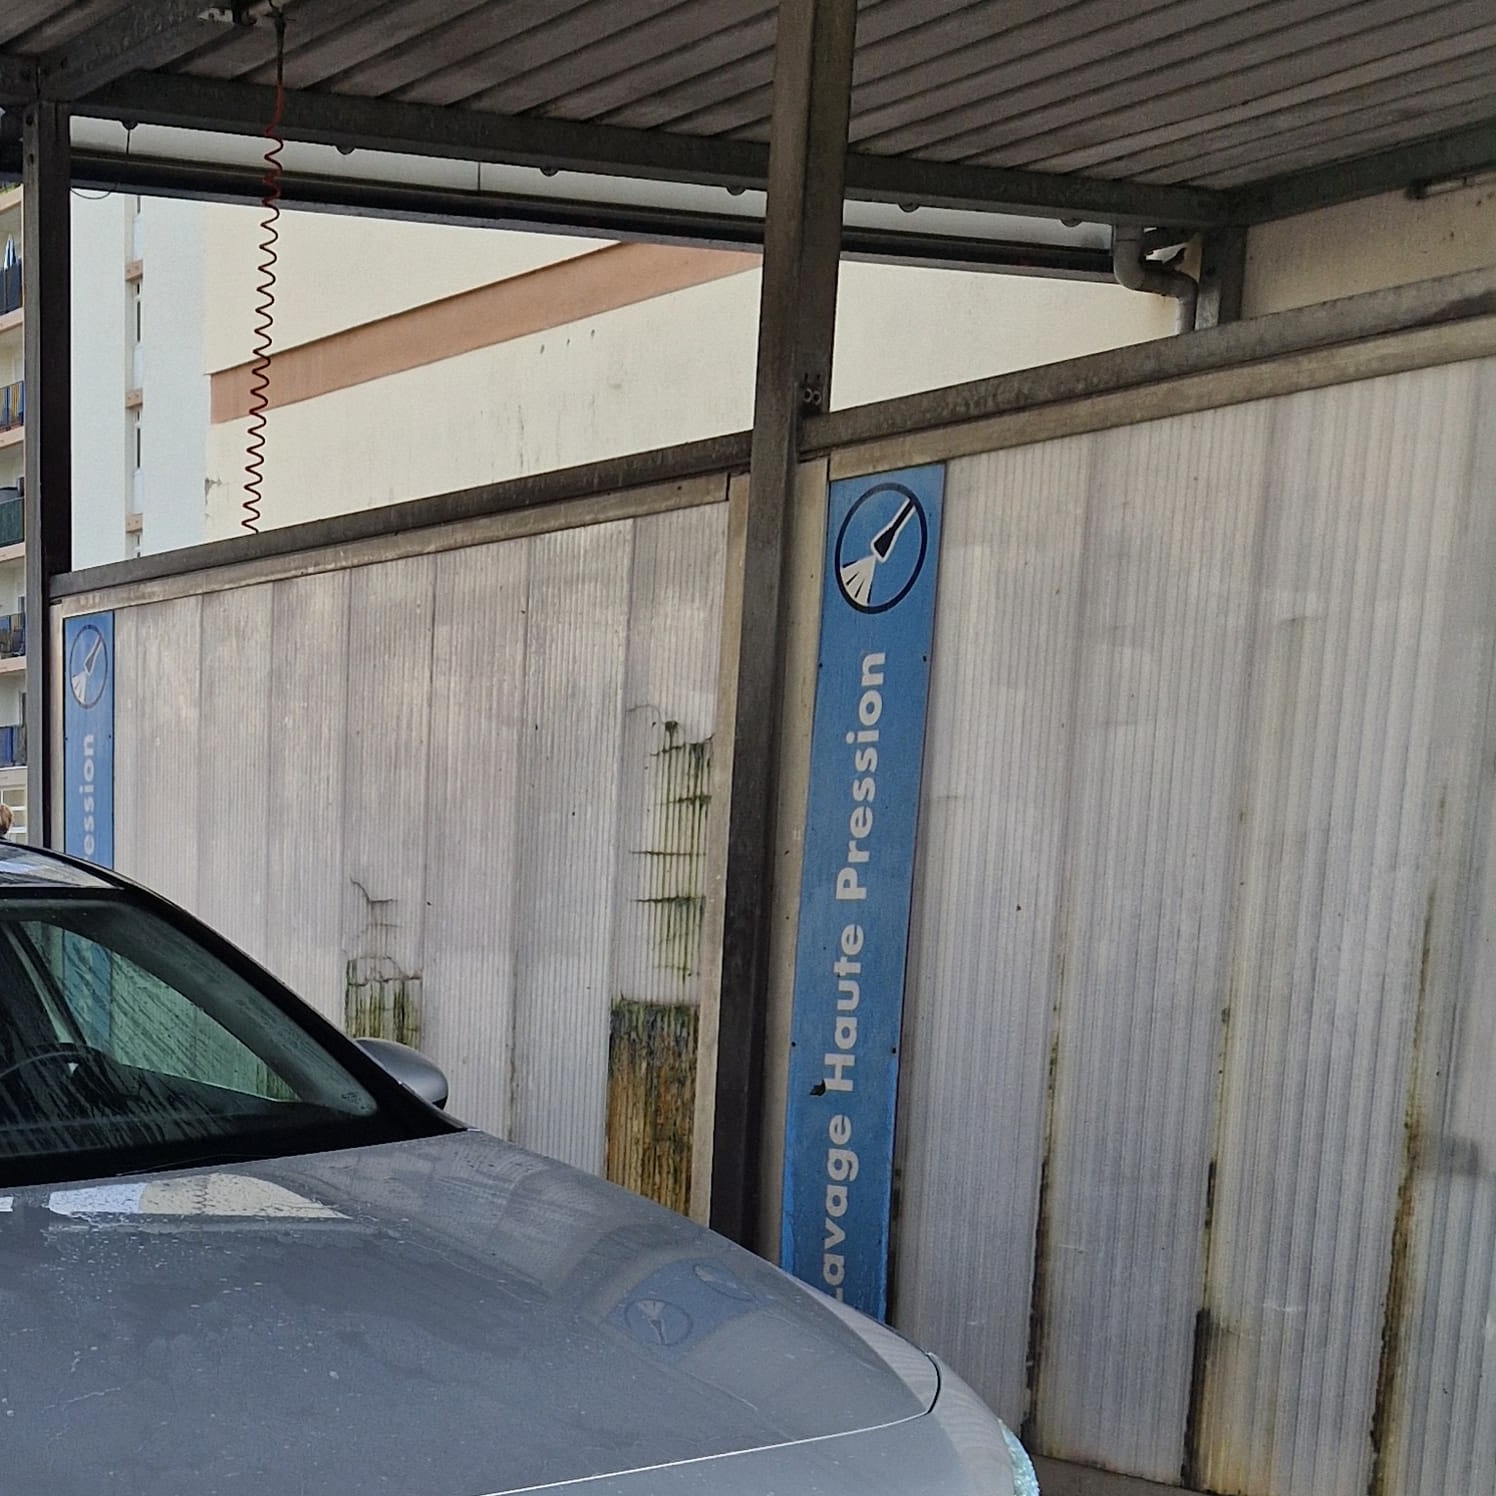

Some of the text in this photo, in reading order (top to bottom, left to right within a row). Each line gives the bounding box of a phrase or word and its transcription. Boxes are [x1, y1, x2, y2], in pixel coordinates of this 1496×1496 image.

[79, 733, 95, 860] ession
[835, 651, 886, 900] Pression
[824, 923, 865, 1092] Haute
